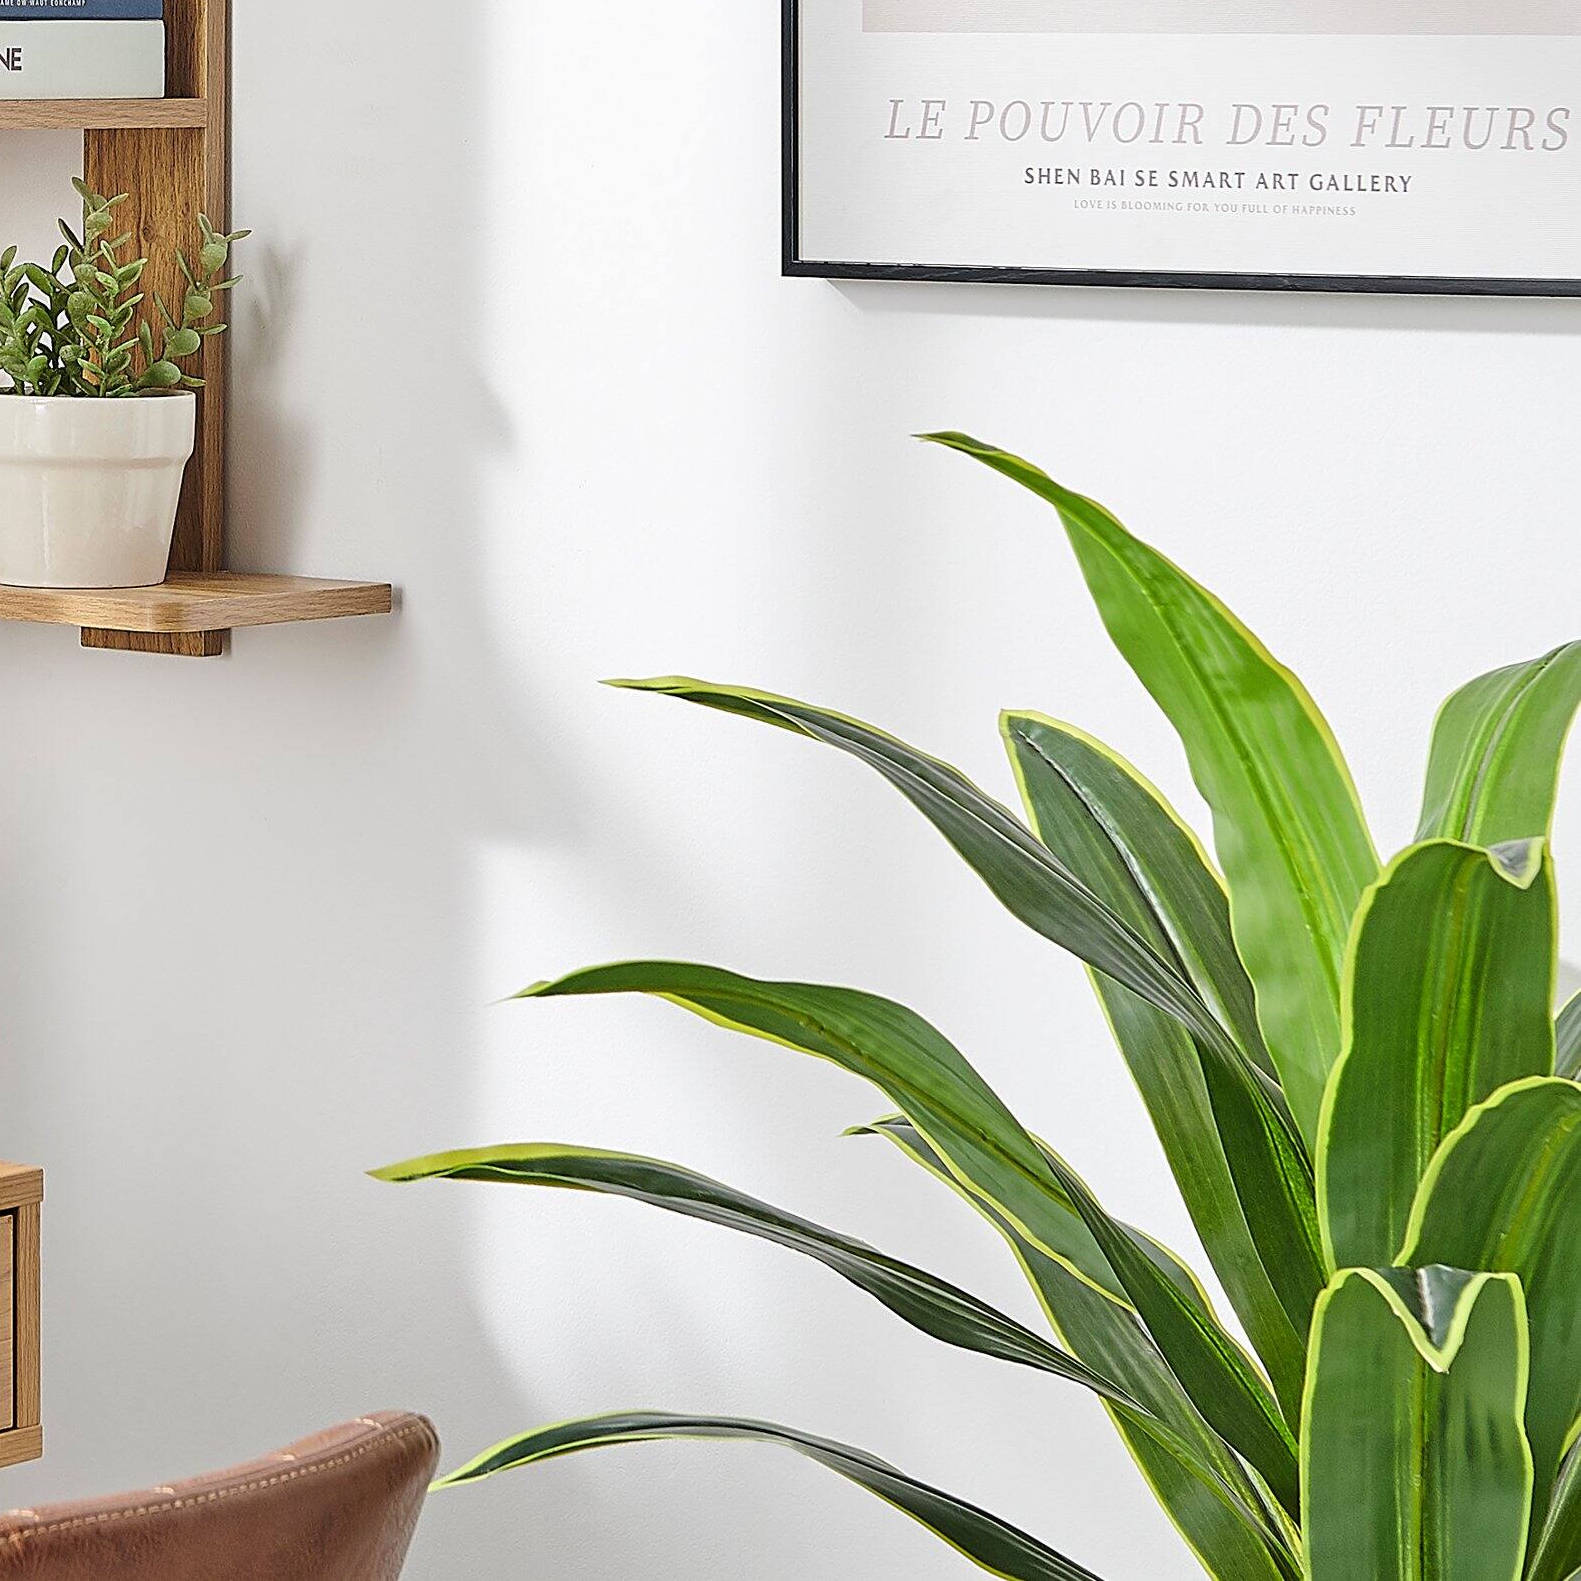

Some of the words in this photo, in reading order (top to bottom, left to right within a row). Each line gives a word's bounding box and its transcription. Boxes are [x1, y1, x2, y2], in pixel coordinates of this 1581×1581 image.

[883, 98, 947, 141] LE
[964, 99, 1205, 146] POUVOIR
[1226, 103, 1330, 149] DES
[1350, 105, 1572, 153] FLEURS
[1024, 167, 1081, 185] SHEN
[1090, 169, 1125, 186] BAI
[1135, 169, 1159, 187] SE
[1168, 170, 1245, 190] SMART
[1255, 173, 1299, 191] ART
[1309, 173, 1412, 193] GALLERY
[1074, 199, 1103, 209] LOVE
[1107, 200, 1117, 210] IS
[1121, 200, 1183, 212] BLOOMING
[1187, 202, 1210, 212] FOR
[1214, 202, 1238, 213] YOU
[1242, 203, 1268, 214] FULL
[1273, 204, 1288, 214] OF
[1292, 205, 1356, 216] HAPPINESS
